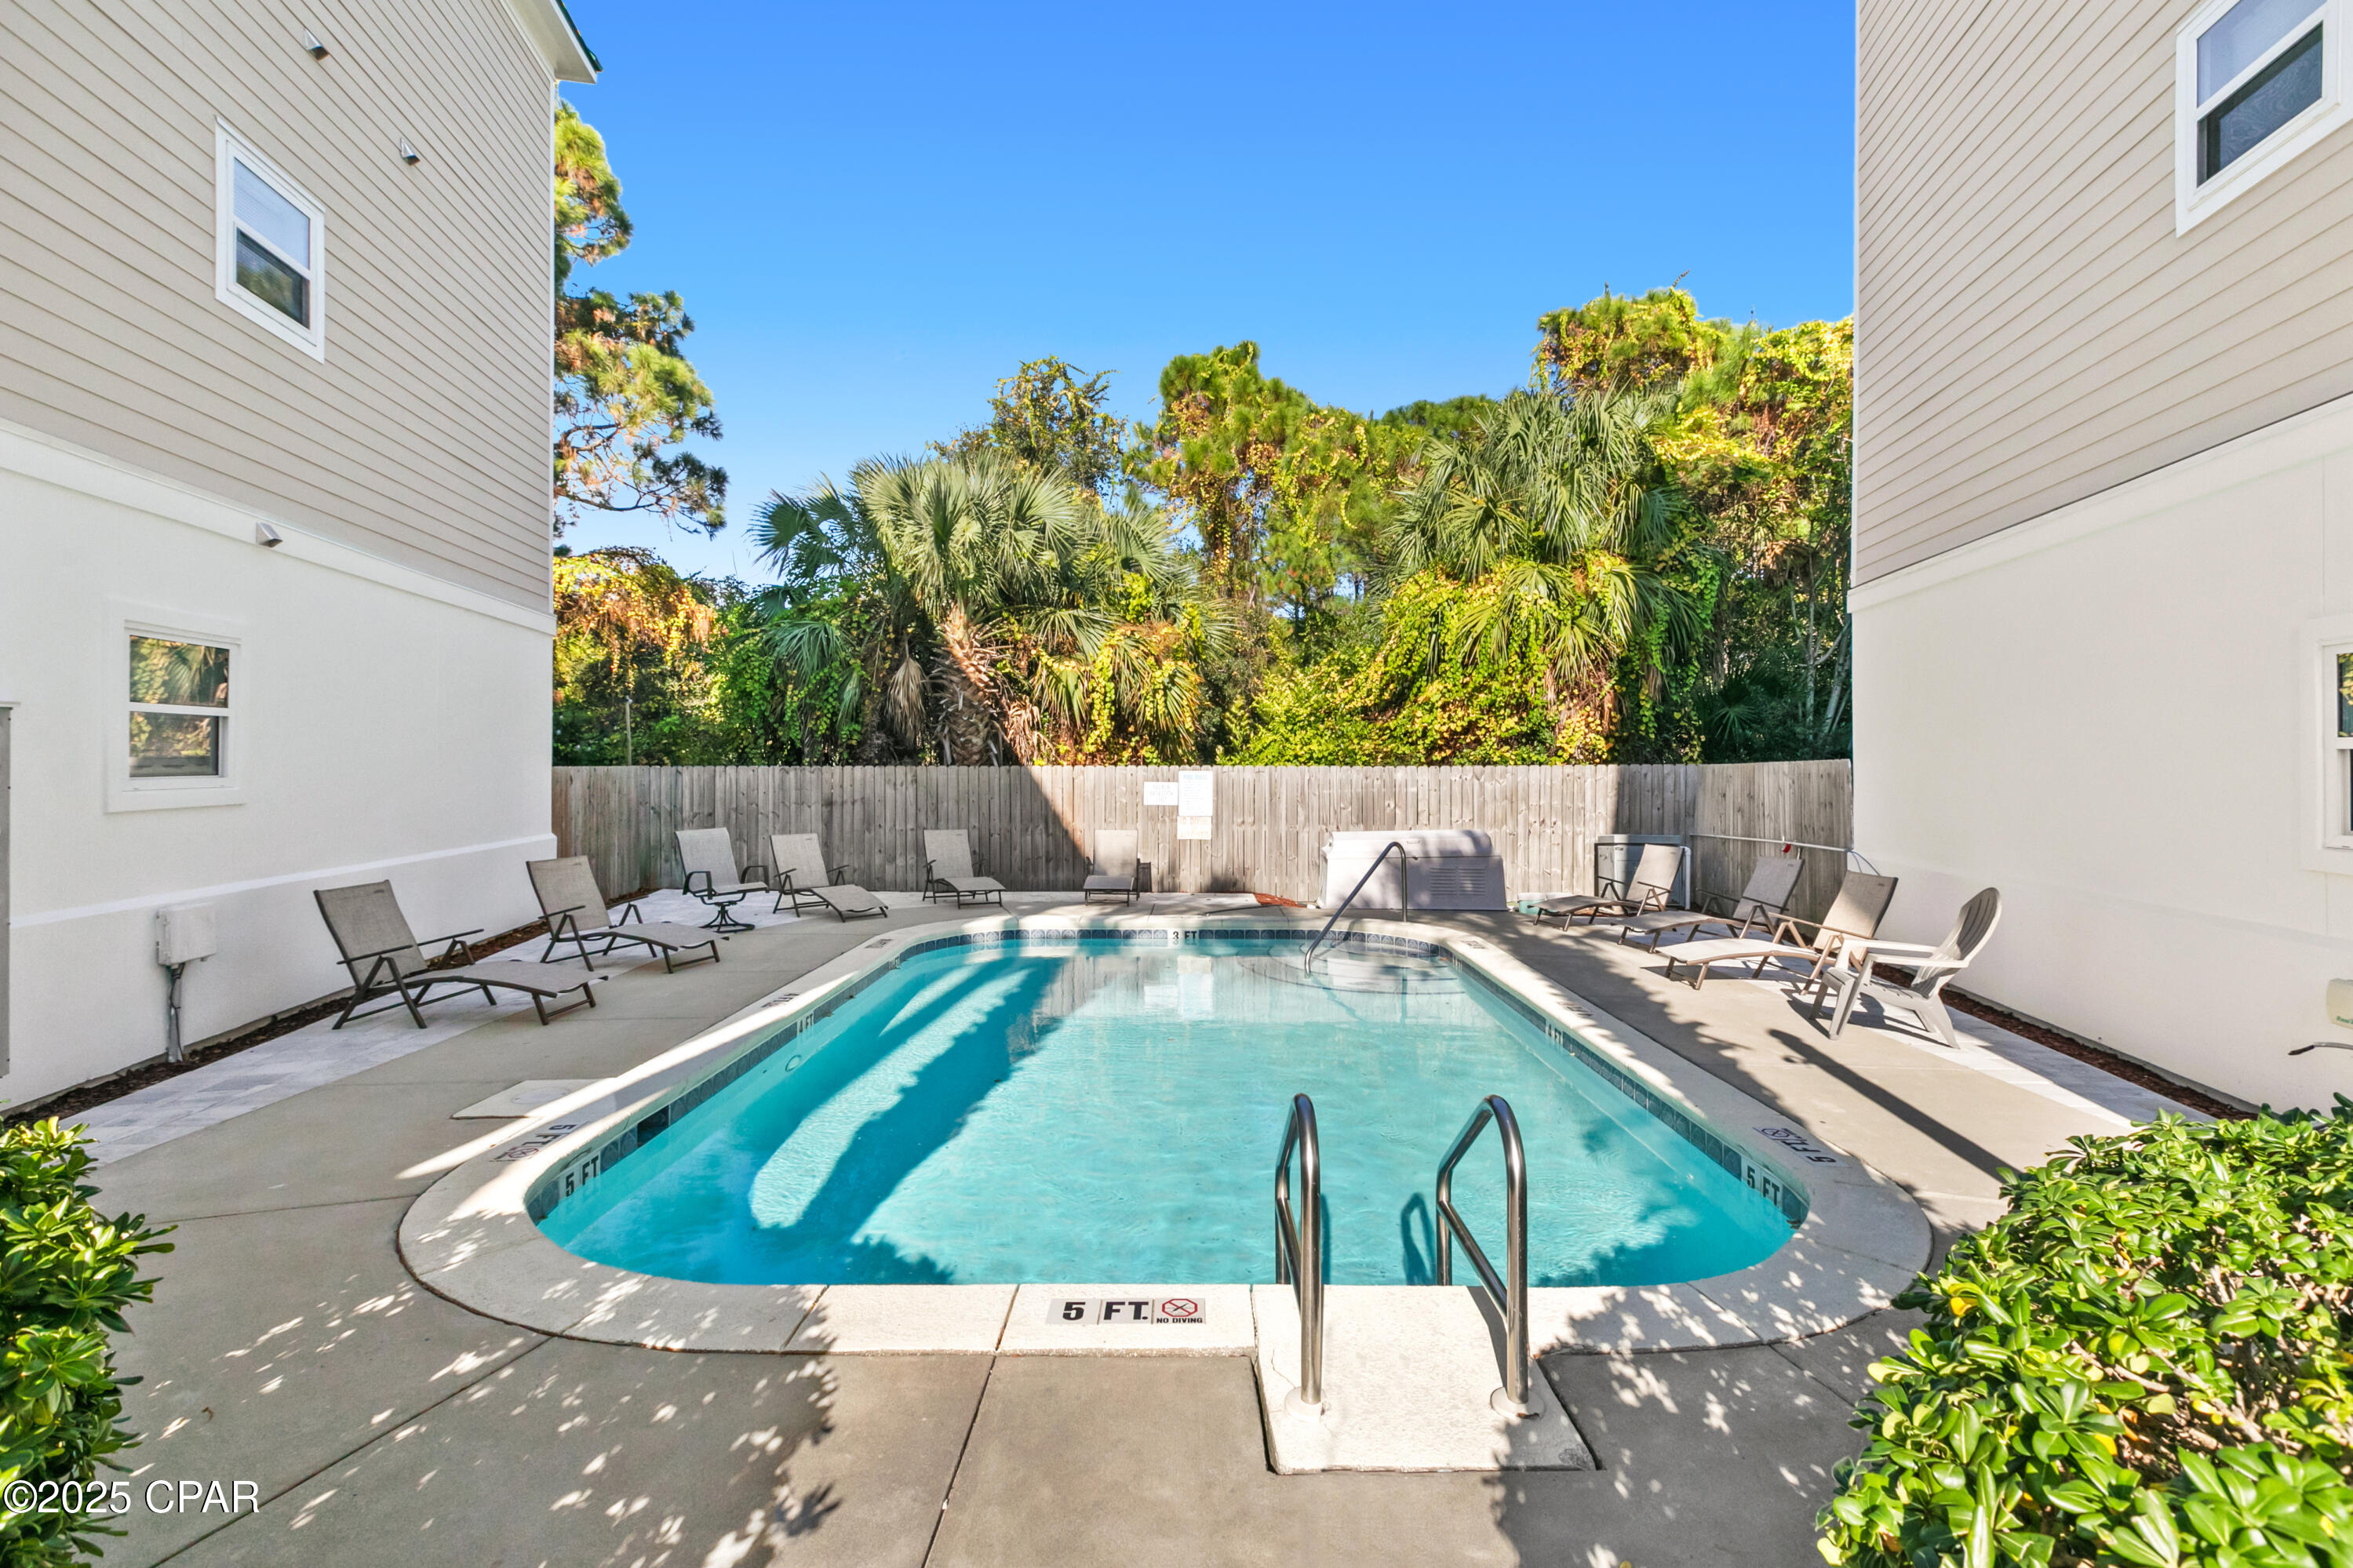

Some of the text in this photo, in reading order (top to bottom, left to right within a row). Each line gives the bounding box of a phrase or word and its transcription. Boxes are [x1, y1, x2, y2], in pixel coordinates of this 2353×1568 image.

[1173, 930, 1197, 940] 3 FT
[565, 1155, 599, 1197] 5 FT
[1747, 1166, 1780, 1206] 5 FT
[1062, 1301, 1149, 1321] 5 FT.
